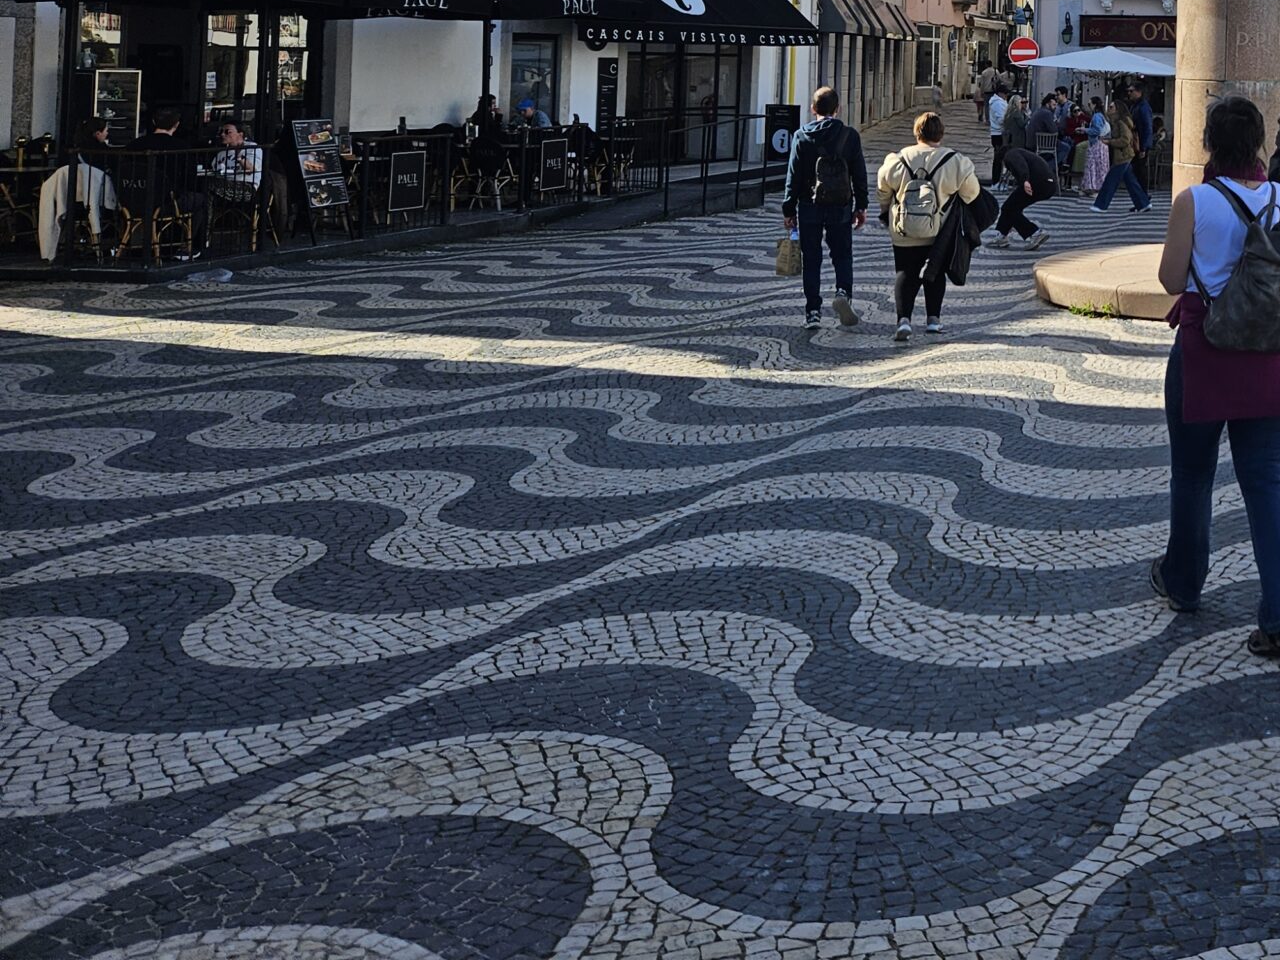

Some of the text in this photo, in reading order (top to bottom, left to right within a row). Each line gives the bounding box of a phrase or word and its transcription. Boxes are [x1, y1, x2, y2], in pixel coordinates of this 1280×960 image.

[587, 28, 816, 45] CASCAIS VISITOR CENTER
[397, 173, 419, 184] PAUL
